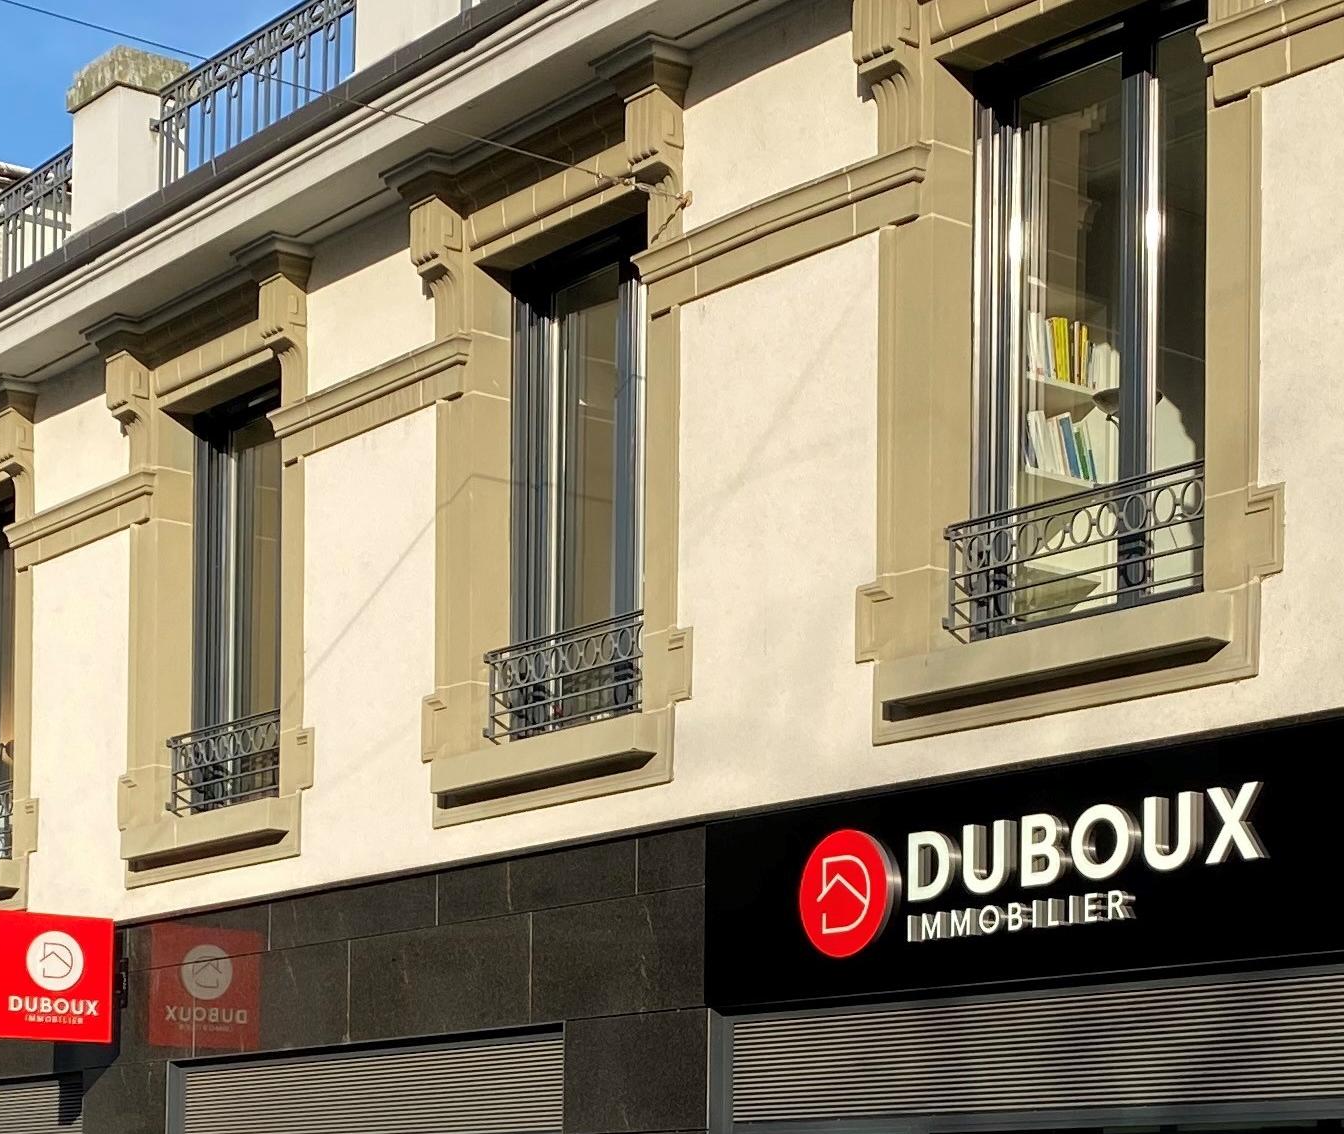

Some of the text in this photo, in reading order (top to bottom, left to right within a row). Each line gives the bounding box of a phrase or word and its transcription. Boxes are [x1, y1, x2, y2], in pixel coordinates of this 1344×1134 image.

[906, 781, 1270, 903] DUBOUX
[906, 888, 1137, 943] IMMOBILIER
[7, 995, 100, 1018] DUBOUX
[24, 1014, 85, 1025] IMMOBILIER
